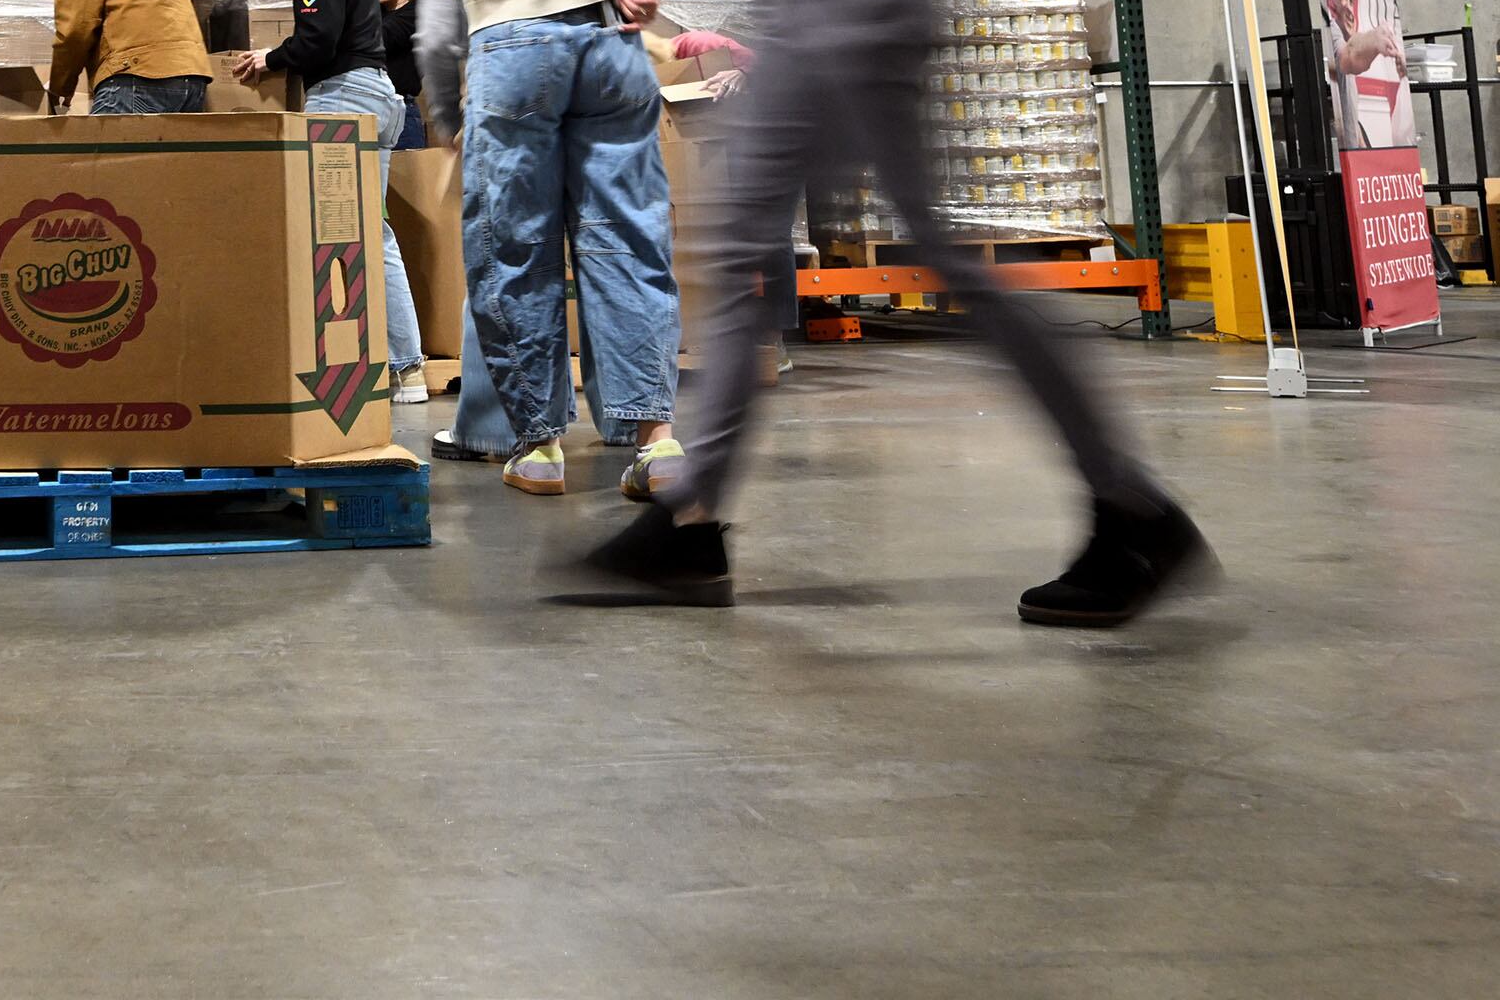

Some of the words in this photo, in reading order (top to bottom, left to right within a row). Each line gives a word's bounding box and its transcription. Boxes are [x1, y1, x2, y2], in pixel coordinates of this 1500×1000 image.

[1357, 173, 1423, 204] FIGHTING
[1363, 212, 1428, 248] HUNGER
[0, 273, 9, 288] BIG
[1370, 254, 1434, 288] STATEWIDE
[1, 290, 15, 312] CHUY
[124, 309, 133, 320] AZ
[69, 321, 110, 338] BRAND
[62, 517, 110, 527] PROPERTY
